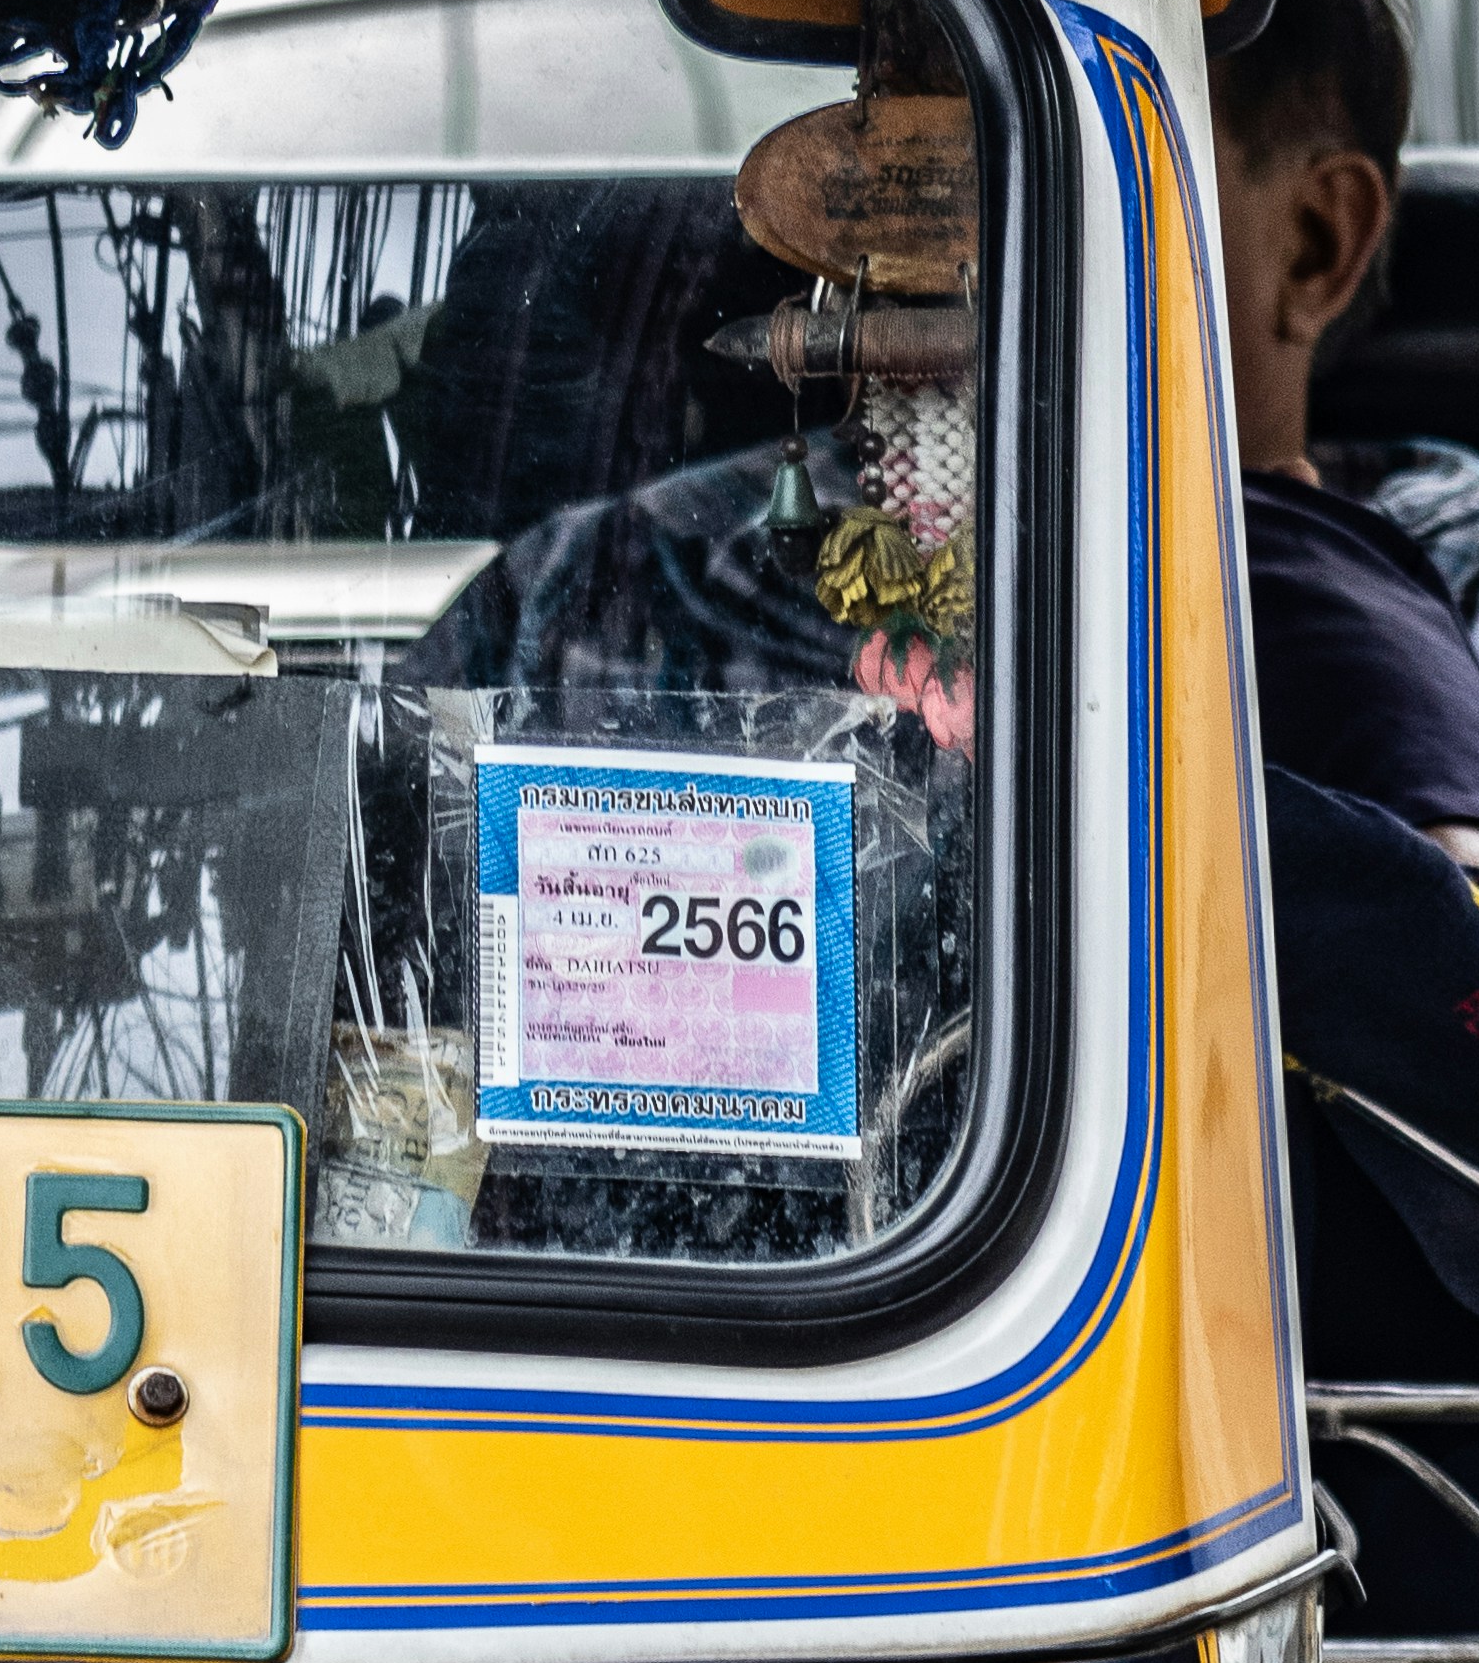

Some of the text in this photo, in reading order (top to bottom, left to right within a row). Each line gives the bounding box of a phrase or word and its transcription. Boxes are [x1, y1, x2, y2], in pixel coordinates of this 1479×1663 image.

[521, 783, 812, 820] กรมการขนส่งทางบก
[624, 845, 662, 866] 625
[533, 870, 630, 906] วันสิ้นอายุ
[552, 909, 619, 929] 4 เม.ย.
[641, 893, 806, 965] 2566
[567, 957, 661, 976] DAIHATSU
[532, 1085, 806, 1122] กระทรวงคมนาคม
